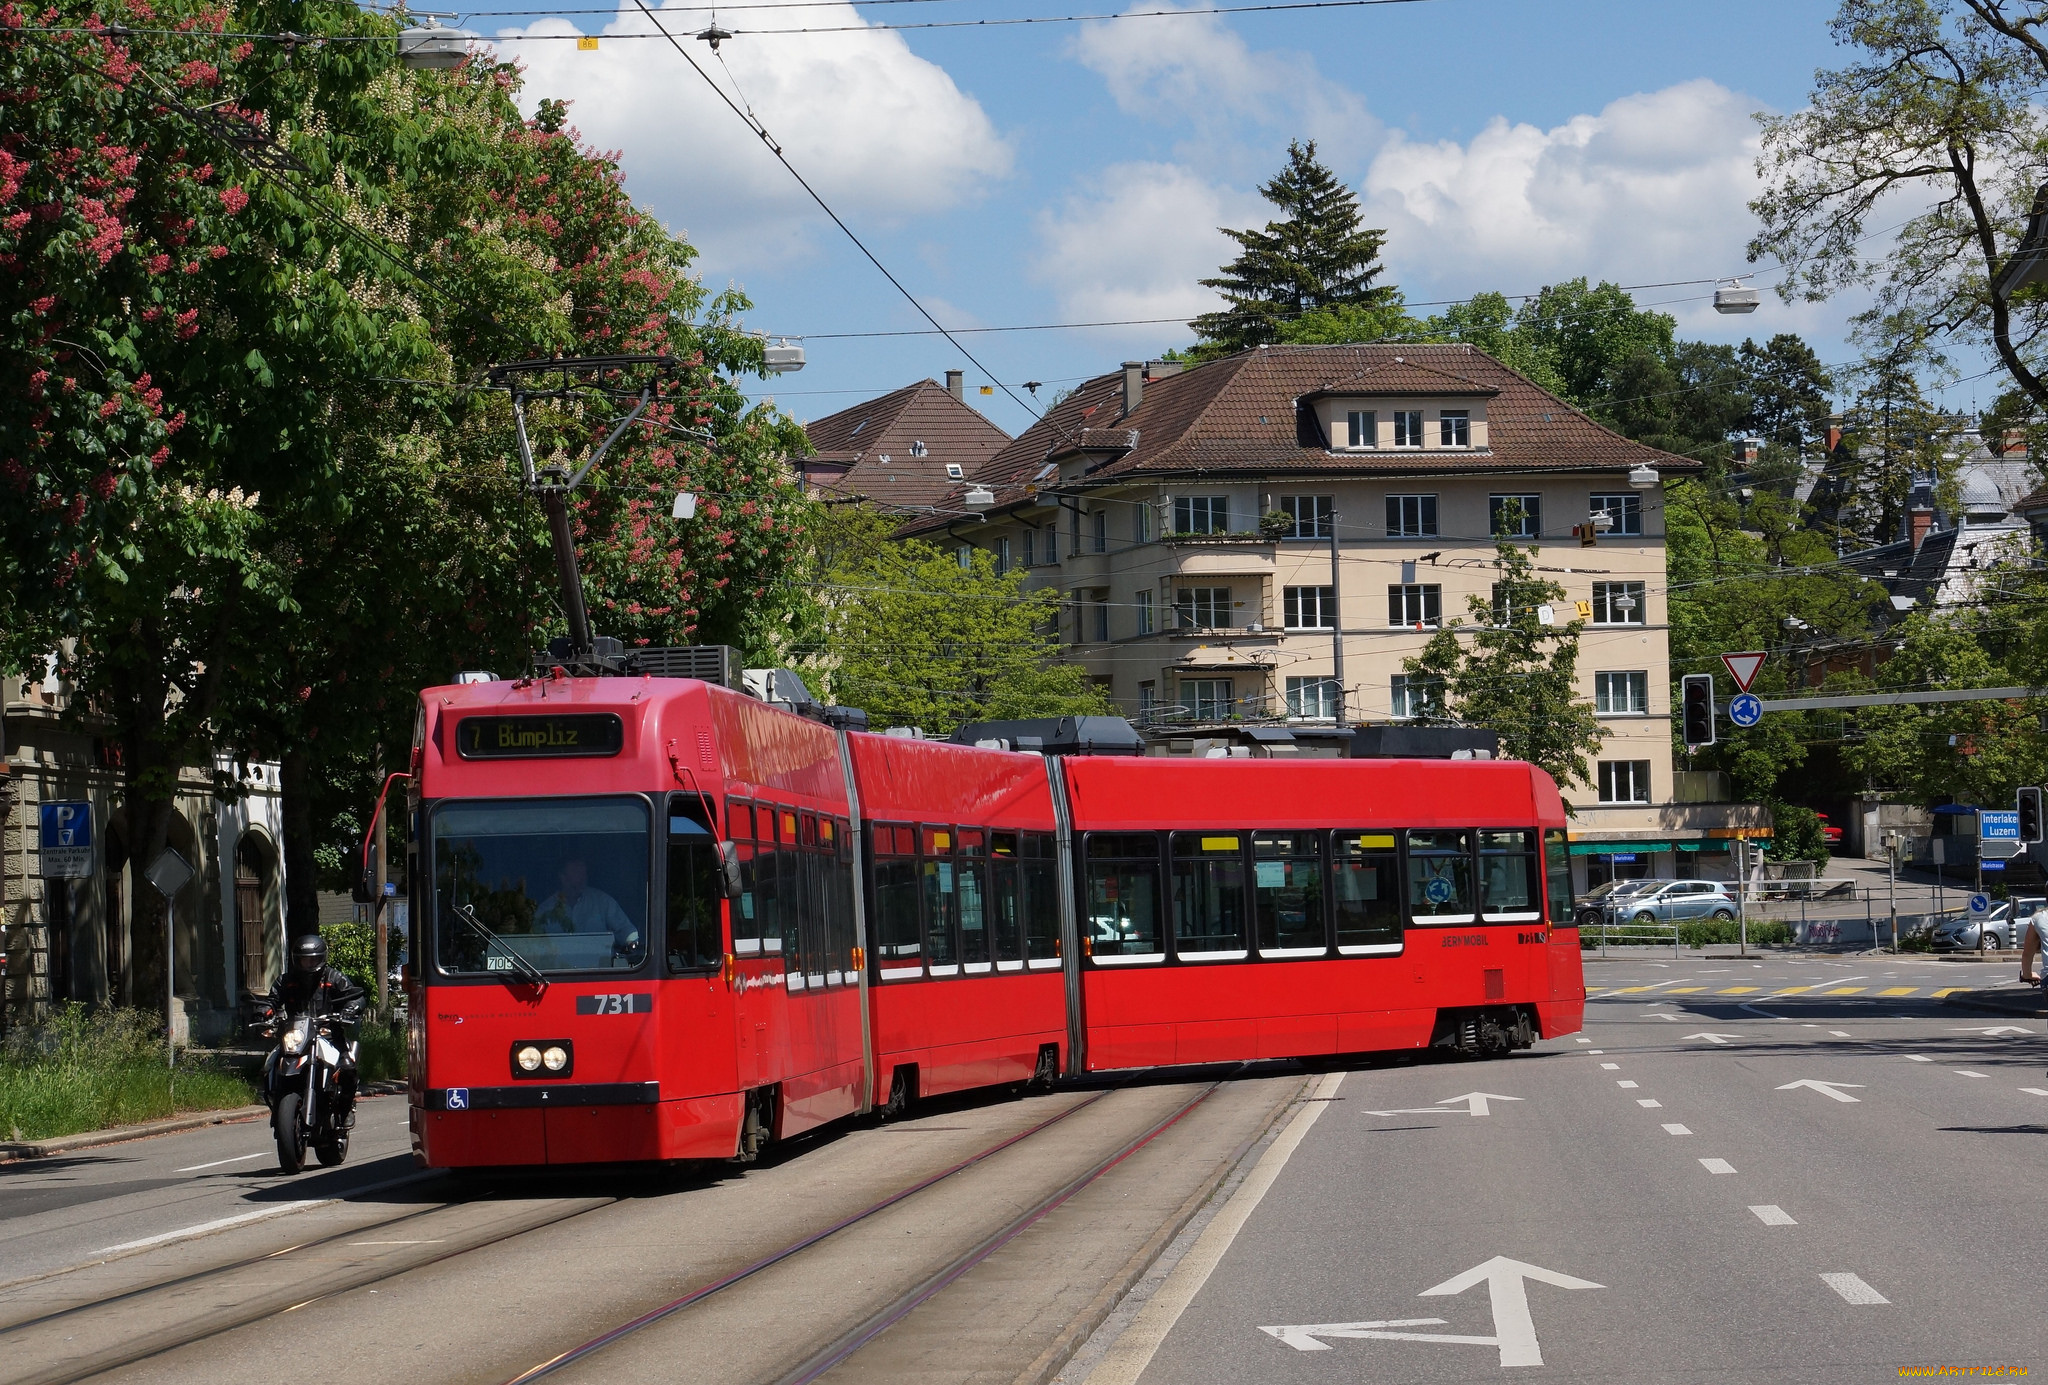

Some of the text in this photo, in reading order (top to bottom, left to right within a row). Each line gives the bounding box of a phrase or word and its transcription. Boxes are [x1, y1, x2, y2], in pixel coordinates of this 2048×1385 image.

[471, 723, 578, 749] 7 Bümpliz
[57, 806, 75, 828] P
[1990, 826, 2016, 836] Luzern
[594, 993, 635, 1015] 731
